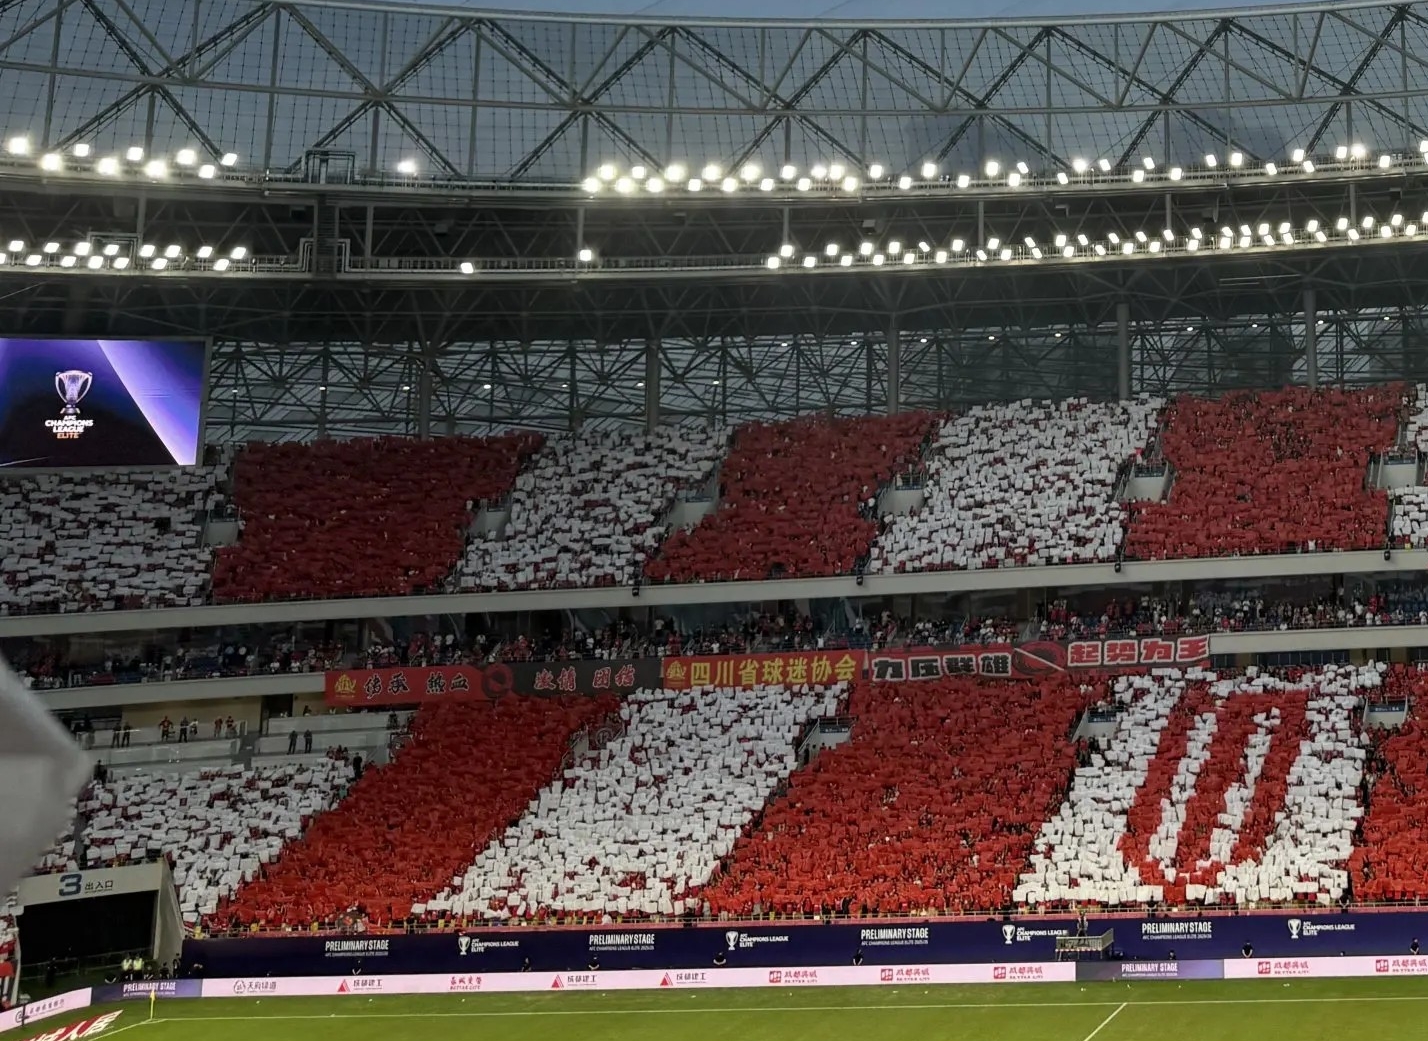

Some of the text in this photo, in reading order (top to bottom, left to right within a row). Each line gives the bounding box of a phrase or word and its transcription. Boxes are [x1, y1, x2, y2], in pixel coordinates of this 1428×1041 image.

[45, 419, 94, 427] CHAMPIONS
[690, 654, 856, 686] 四川省球迷协会
[58, 874, 114, 897] 3 出入口
[861, 927, 929, 940] PRELIMINARY STAGE
[1142, 921, 1212, 934] PRELIMINARY STAGE
[325, 939, 390, 951] PRELIMINARY STAGE
[589, 933, 655, 945] PRELIMINARY STAGE
[1121, 962, 1178, 973] PRELIMINARY STAGE
[123, 981, 176, 993] PRELIMINARY STAGE
